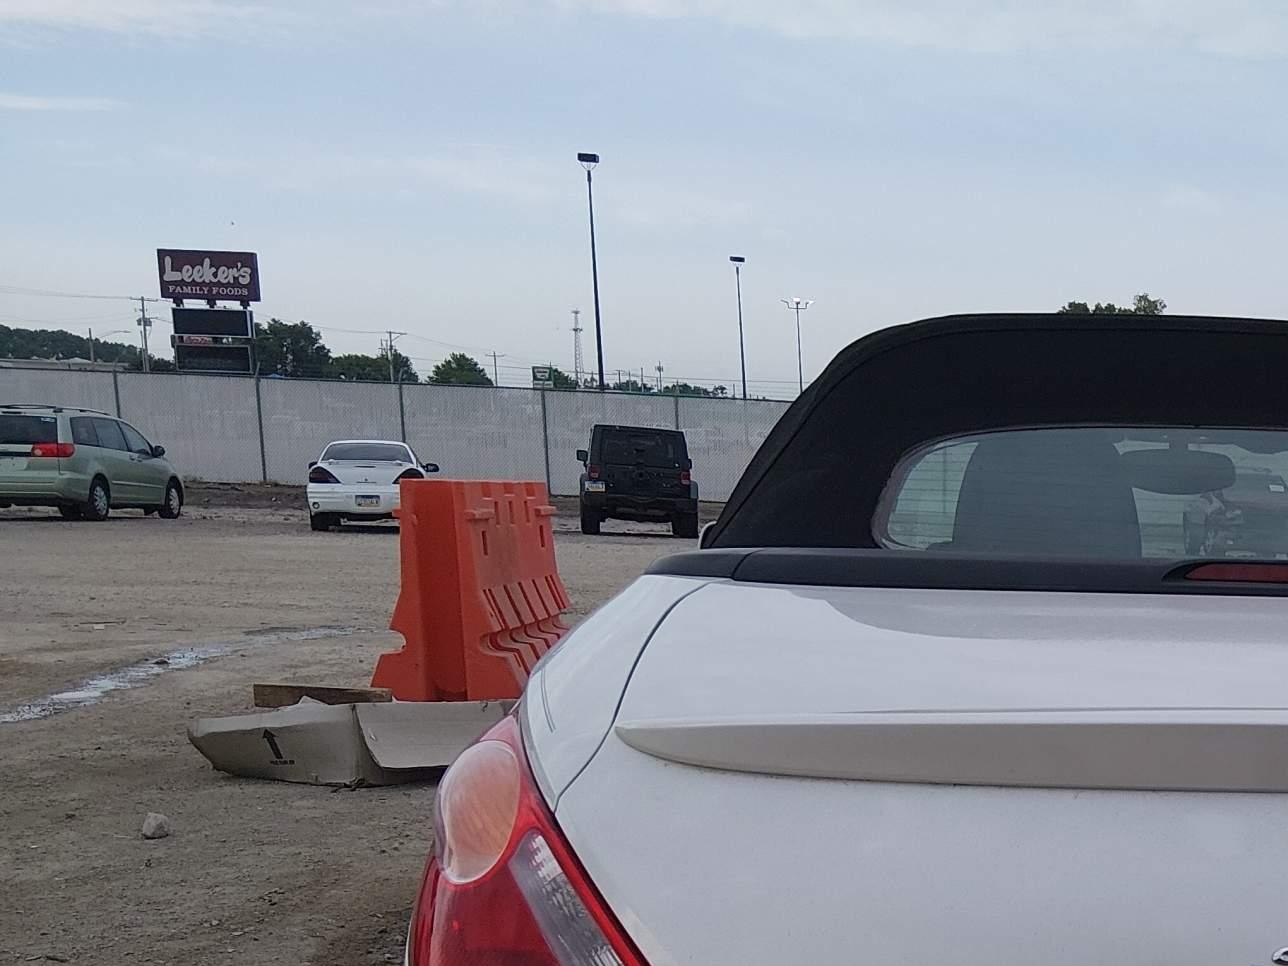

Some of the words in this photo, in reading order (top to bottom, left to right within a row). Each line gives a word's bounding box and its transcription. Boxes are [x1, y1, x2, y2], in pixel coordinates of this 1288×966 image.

[163, 256, 251, 285] Leeker's
[169, 285, 209, 294] FAMILY
[212, 286, 248, 296] FOODS
